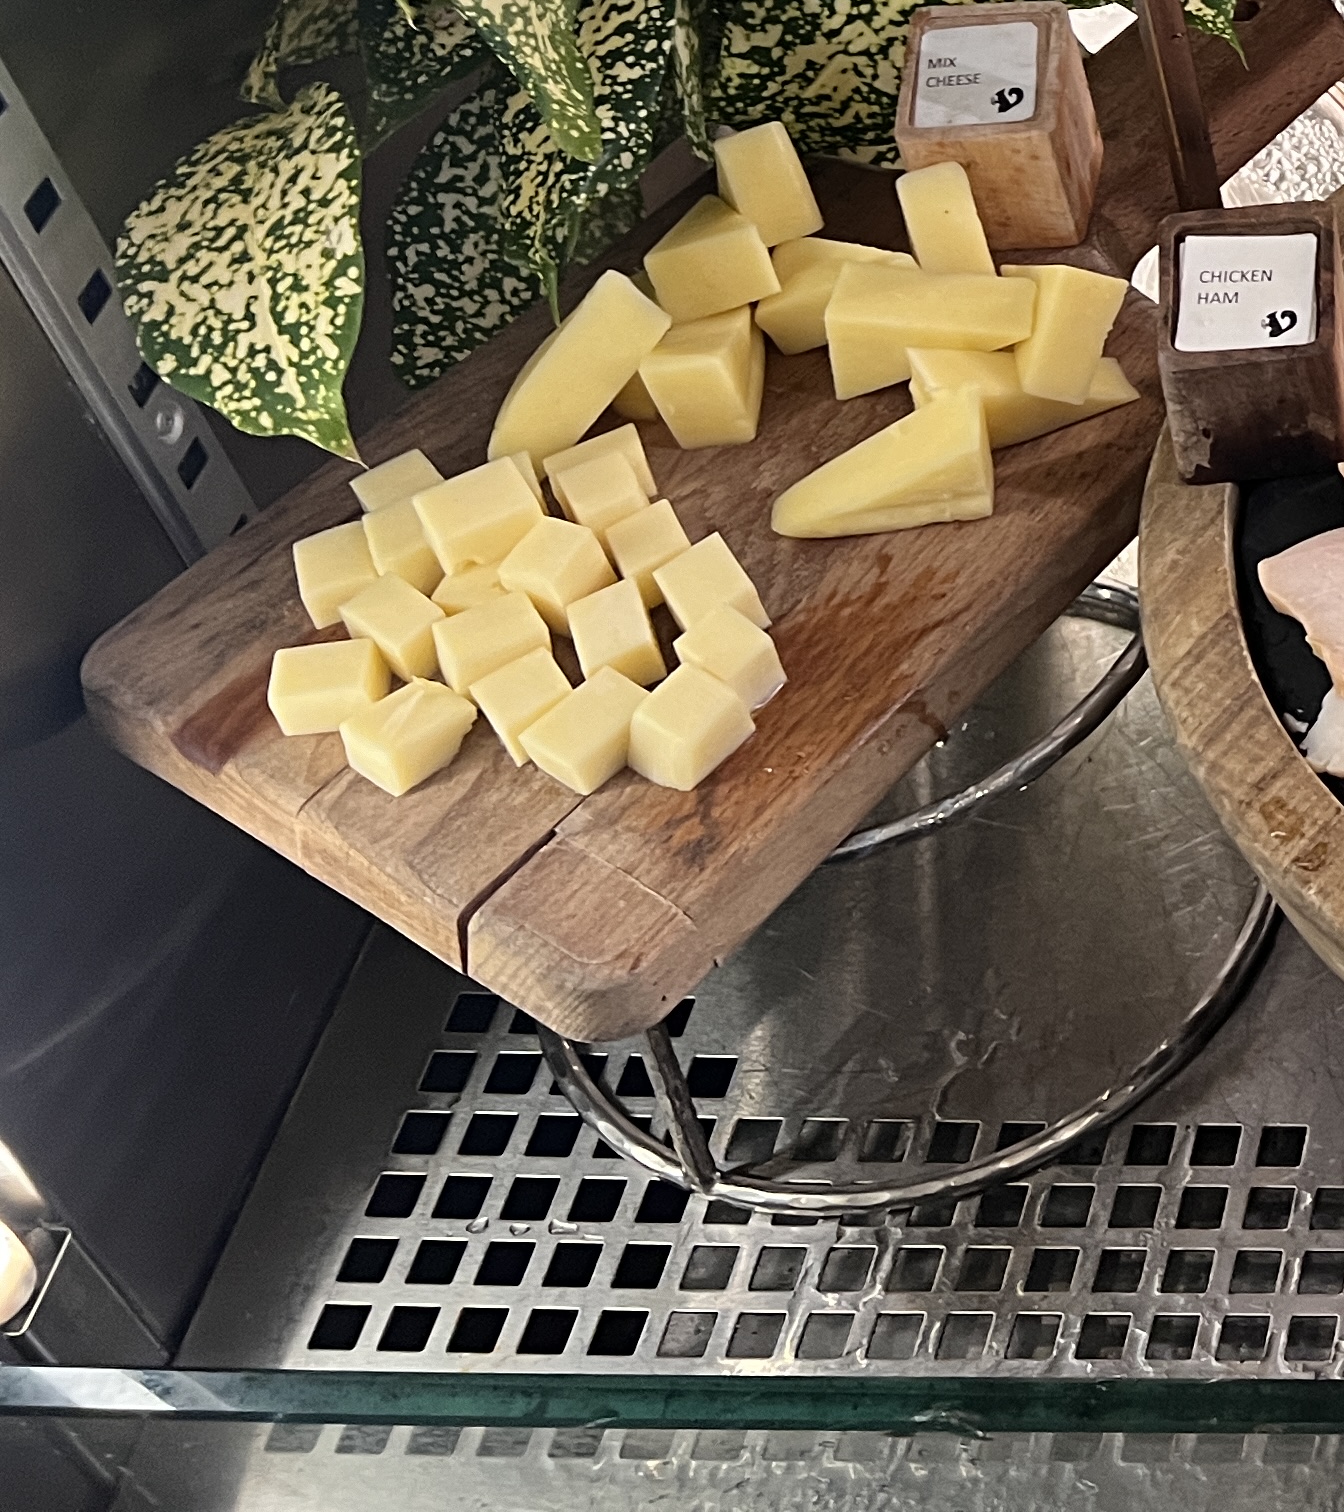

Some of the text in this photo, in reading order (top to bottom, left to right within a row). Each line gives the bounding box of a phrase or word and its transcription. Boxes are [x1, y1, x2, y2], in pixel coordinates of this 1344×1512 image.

[927, 57, 957, 70] MIX
[925, 73, 982, 88] CHEESE
[1199, 269, 1273, 284] CHICKEN
[1197, 291, 1239, 305] HAM
